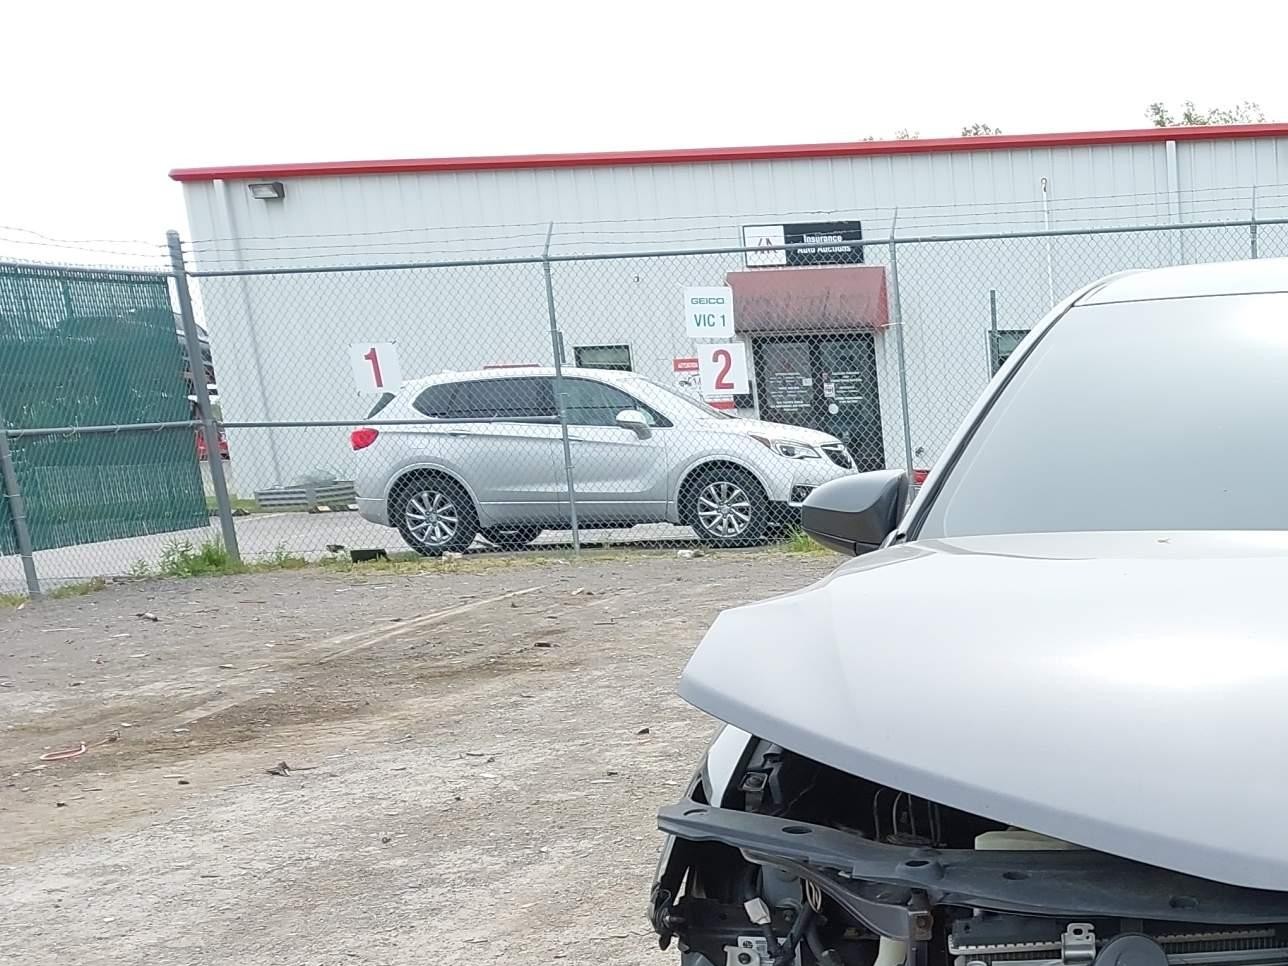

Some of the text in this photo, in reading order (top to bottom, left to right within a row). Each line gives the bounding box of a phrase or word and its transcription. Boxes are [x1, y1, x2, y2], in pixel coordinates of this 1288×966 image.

[803, 233, 843, 244] Insurance
[691, 297, 725, 305] GEICO
[694, 314, 726, 327] VIC 1
[364, 347, 383, 388] 1
[712, 349, 735, 390] 2
